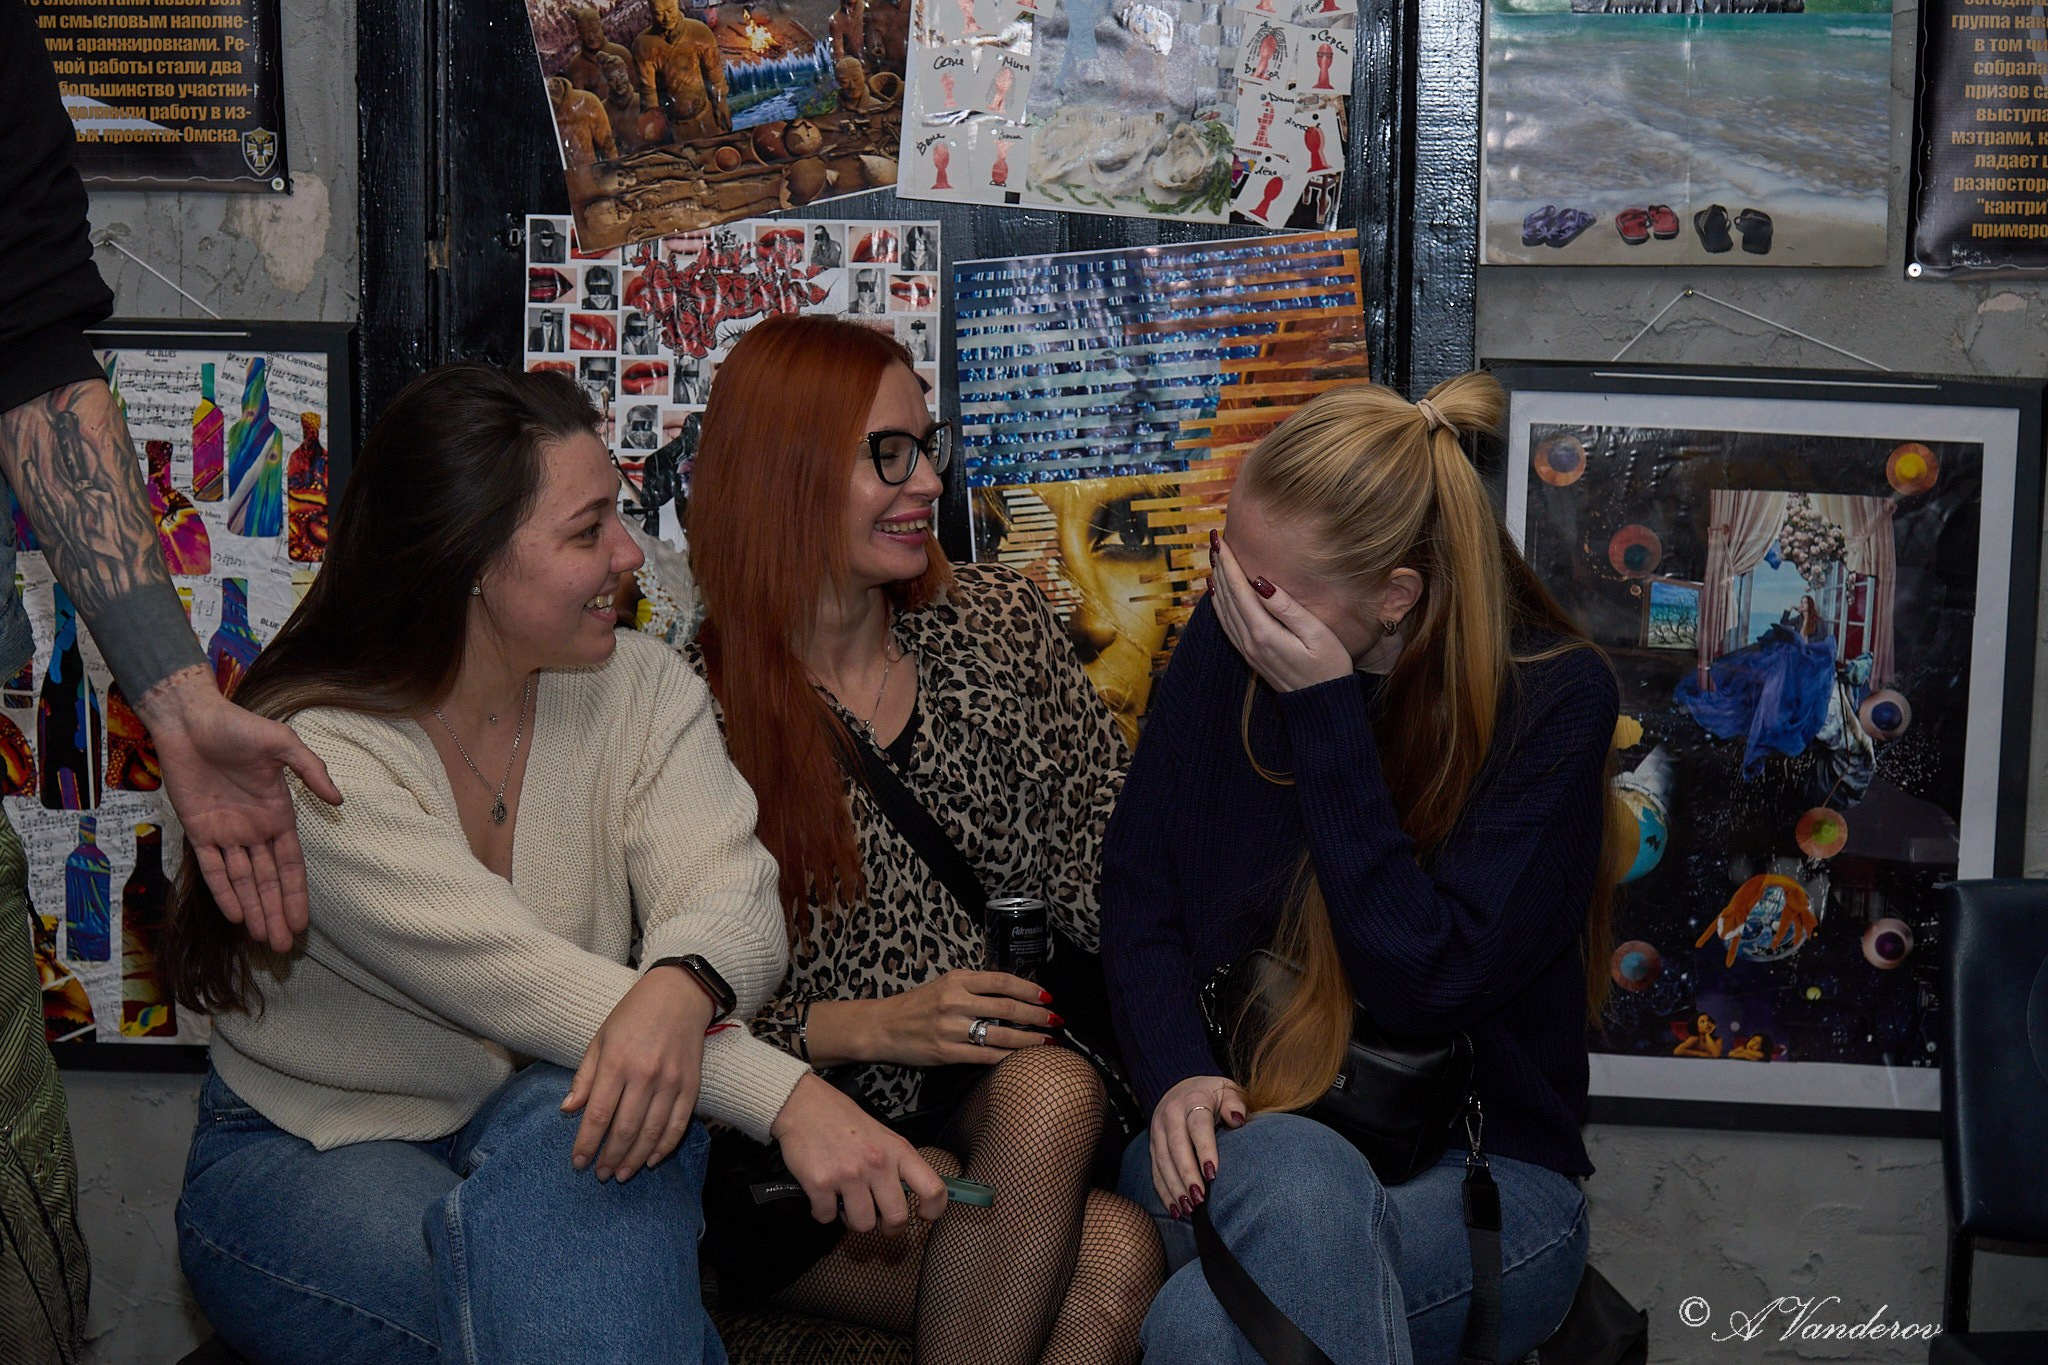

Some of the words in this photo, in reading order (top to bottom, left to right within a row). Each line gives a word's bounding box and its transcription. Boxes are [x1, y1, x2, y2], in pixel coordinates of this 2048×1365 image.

[60, 15, 168, 29] смысловым
[171, 15, 249, 29] наполне-
[1951, 15, 2011, 31] группа
[2014, 15, 2048, 29] нак
[77, 38, 221, 54] аранжировками.
[224, 36, 251, 52] Ре-
[1974, 38, 1986, 52] в
[1990, 38, 2022, 52] том
[89, 58, 154, 76] работы
[156, 61, 207, 75] стали
[210, 61, 242, 77] два
[1974, 59, 2048, 77] собрала
[59, 81, 176, 98] большинство
[178, 83, 253, 100] участни-
[1965, 84, 2030, 100] призов
[149, 103, 208, 122] работу
[211, 106, 221, 120] в
[225, 106, 252, 120] из-
[1976, 108, 2048, 124] выступа
[103, 128, 183, 144] проектах
[183, 126, 241, 143] Омска.
[1951, 131, 2035, 148] мэтрами,
[1973, 154, 2039, 171] ладает
[1953, 177, 2048, 194] разностор
[1971, 223, 2048, 240] примеро
